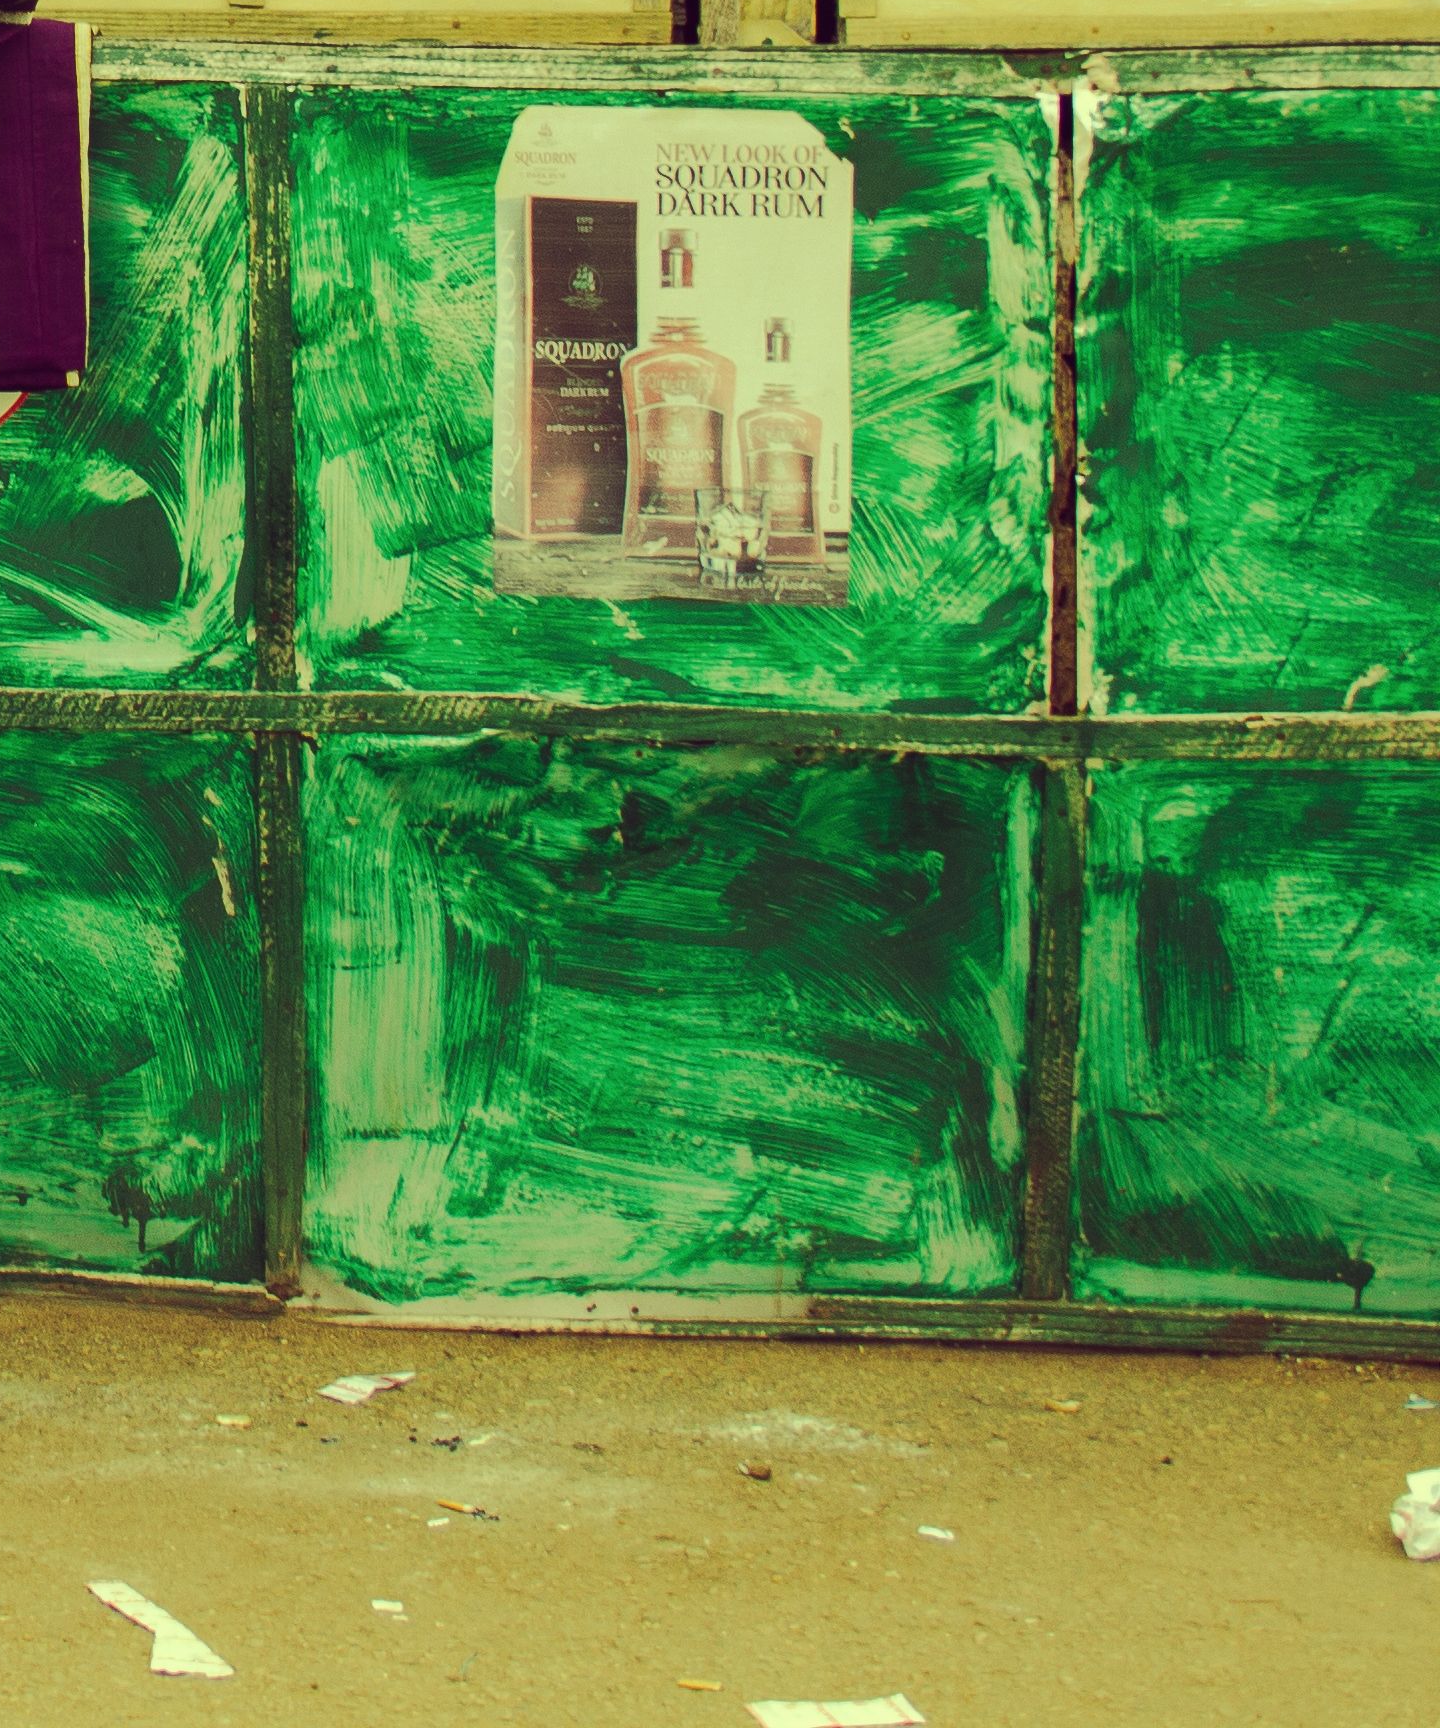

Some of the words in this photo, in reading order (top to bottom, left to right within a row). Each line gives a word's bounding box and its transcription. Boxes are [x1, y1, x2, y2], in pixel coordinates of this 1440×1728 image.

[515, 151, 577, 166] SQUADRON
[656, 144, 715, 164] NEW
[722, 144, 788, 164] LOOK
[794, 144, 826, 165] OF
[656, 164, 828, 194] SQUADRON
[657, 192, 740, 218] DARK
[751, 192, 824, 218] RUM
